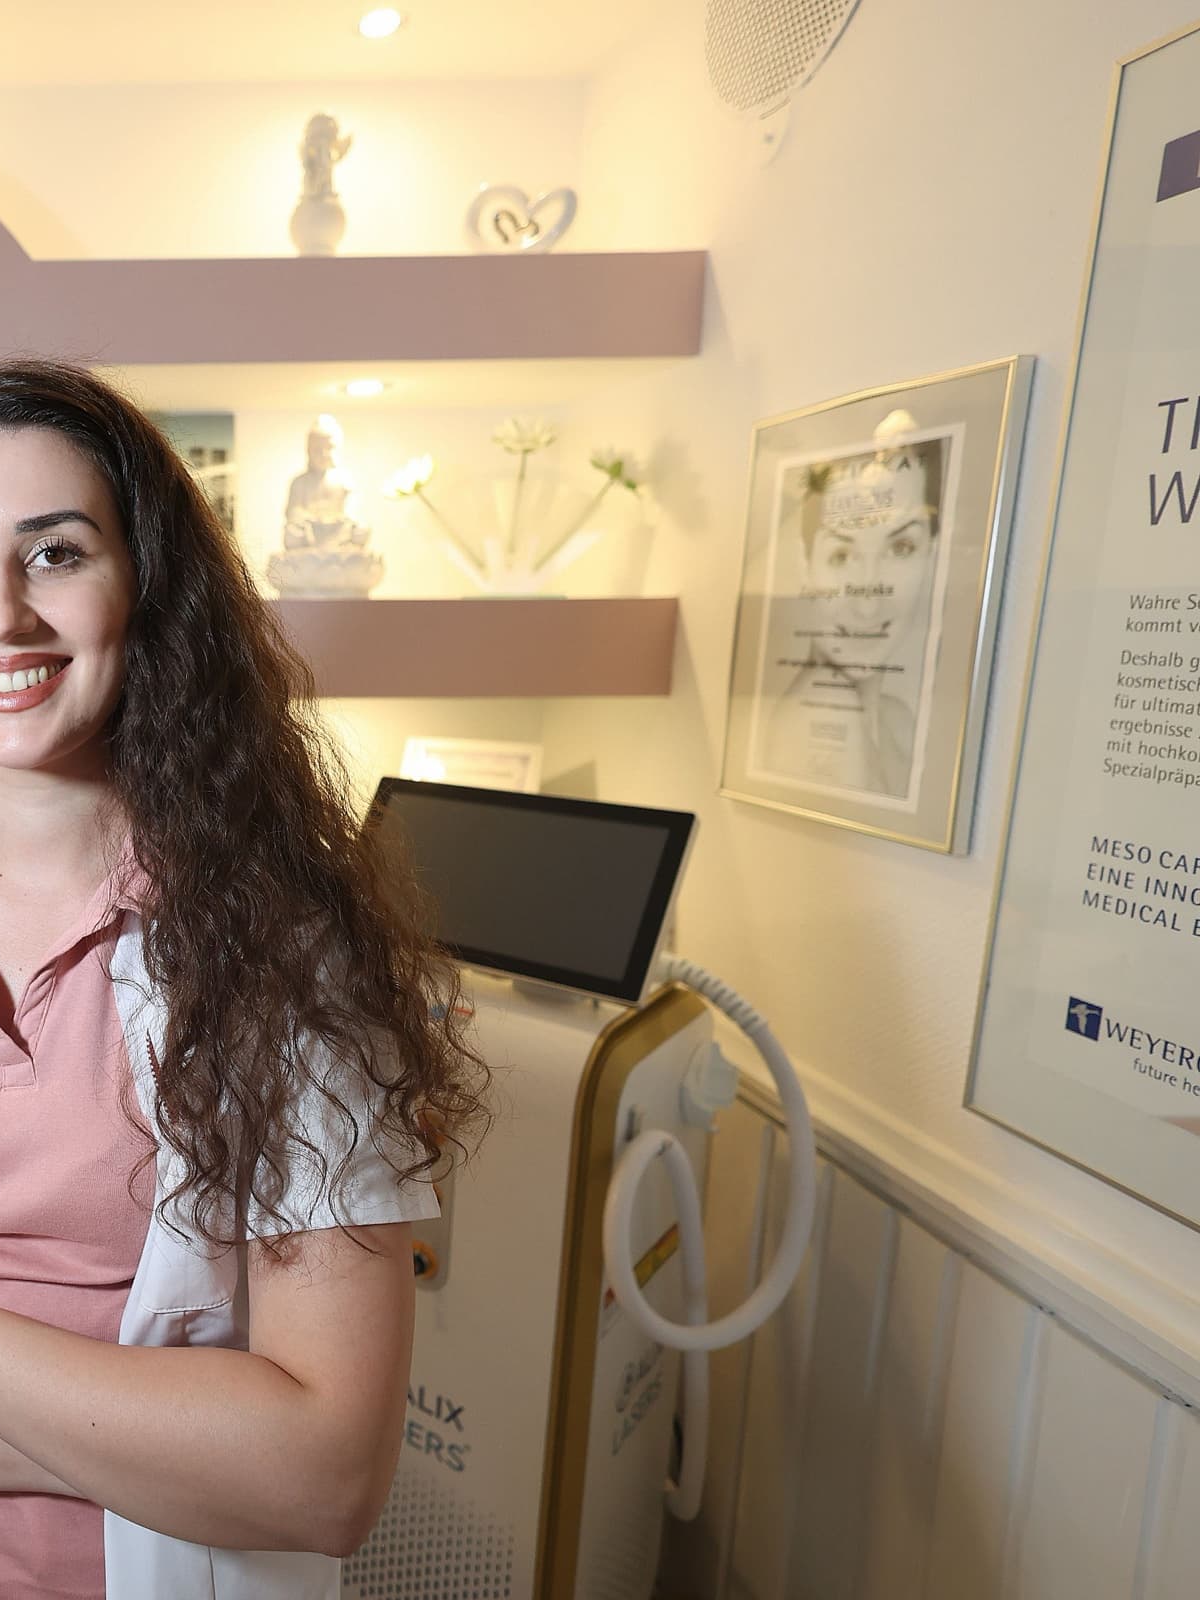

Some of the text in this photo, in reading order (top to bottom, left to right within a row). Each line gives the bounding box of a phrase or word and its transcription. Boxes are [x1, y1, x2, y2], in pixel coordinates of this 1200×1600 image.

[1129, 593, 1181, 610] Wahre
[1126, 616, 1200, 633] kommt v
[1120, 648, 1184, 668] Deshalb
[1114, 693, 1137, 710] für
[1109, 718, 1193, 738] ergebnisse
[1106, 738, 1200, 763] mit hochko
[1091, 835, 1152, 864] MESO
[1086, 863, 1135, 890] EINE
[1081, 889, 1182, 932] MEDICAL
[1105, 1018, 1200, 1073] WEYER
[1133, 1058, 1178, 1087] future
